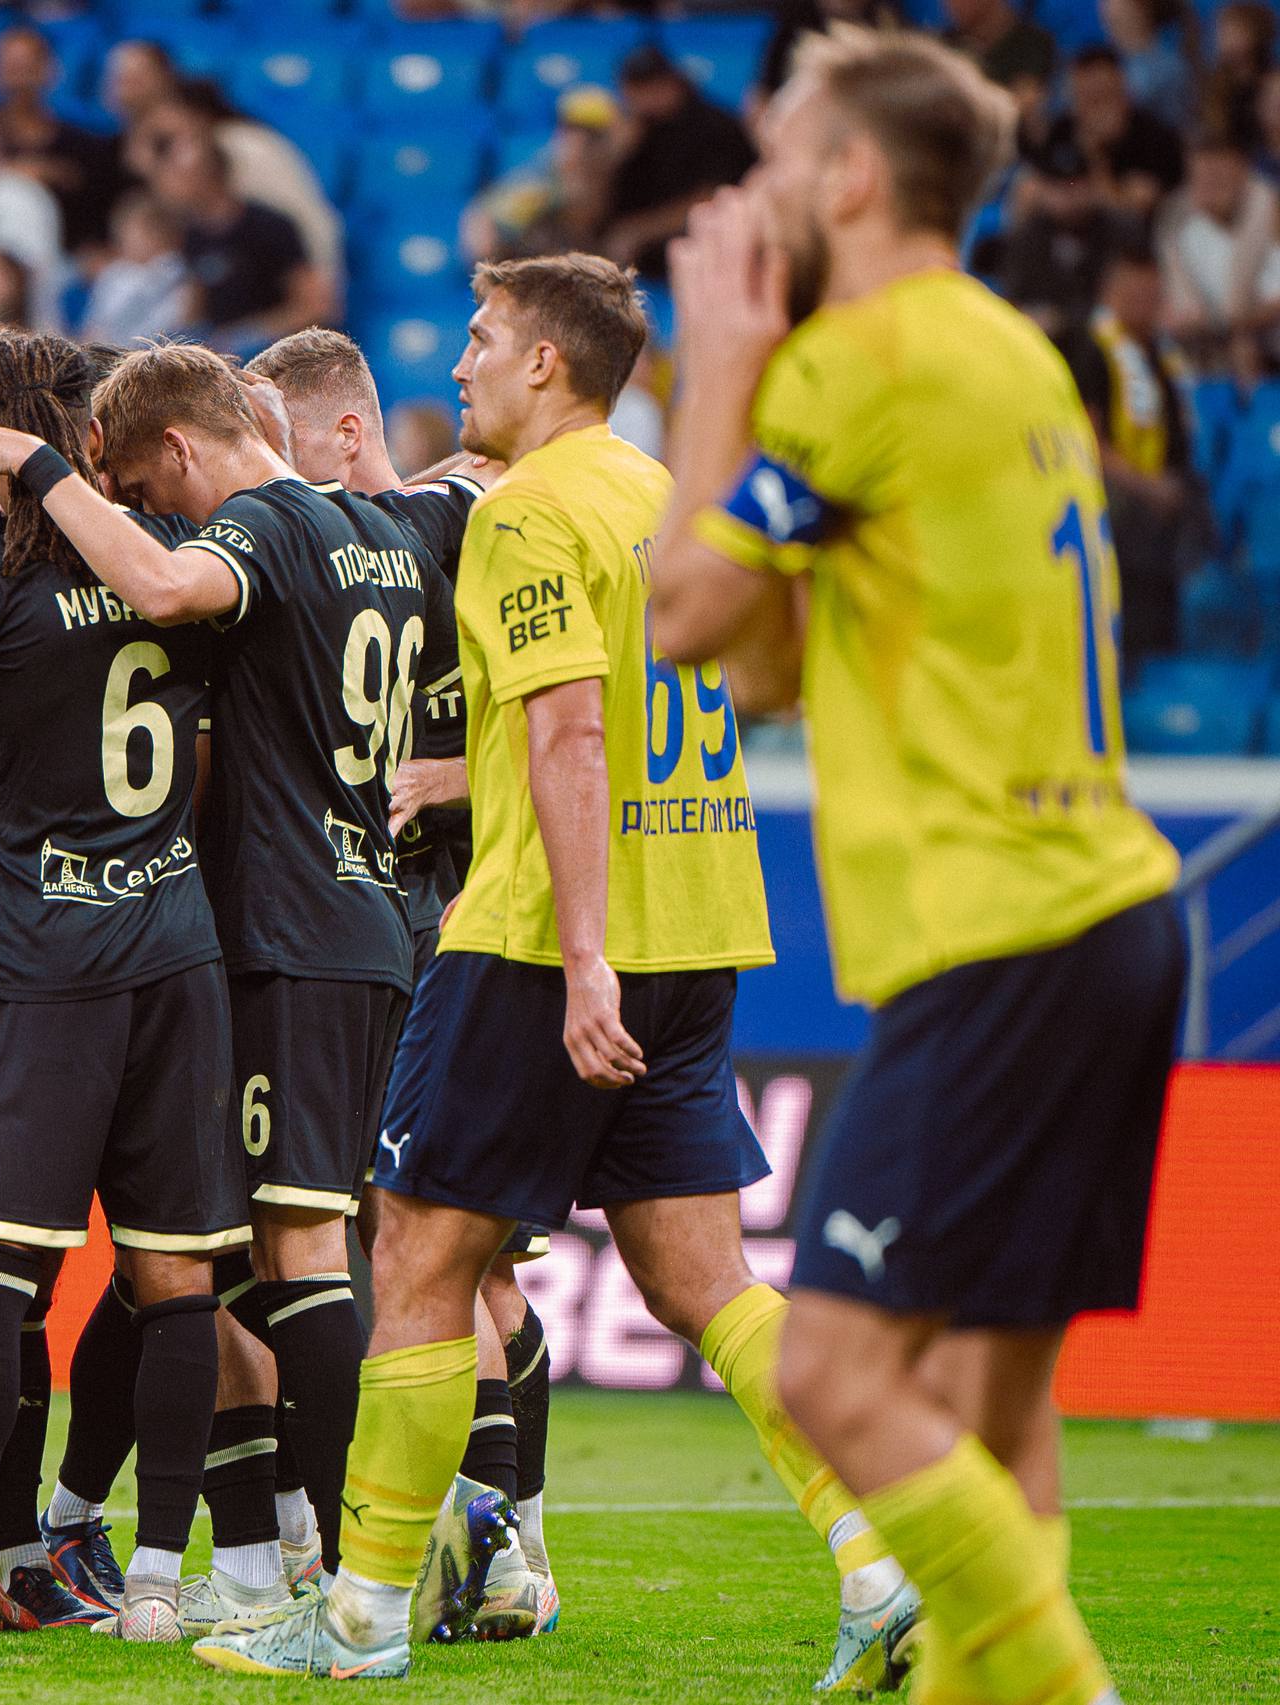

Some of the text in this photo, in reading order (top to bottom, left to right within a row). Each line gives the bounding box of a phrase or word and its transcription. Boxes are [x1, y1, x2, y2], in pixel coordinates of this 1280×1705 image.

[500, 574, 565, 625] FON
[508, 604, 573, 655] BET
[102, 640, 175, 818] 6
[42, 881, 99, 897] ДАГНЕФТЬ
[242, 1074, 272, 1157] 6
